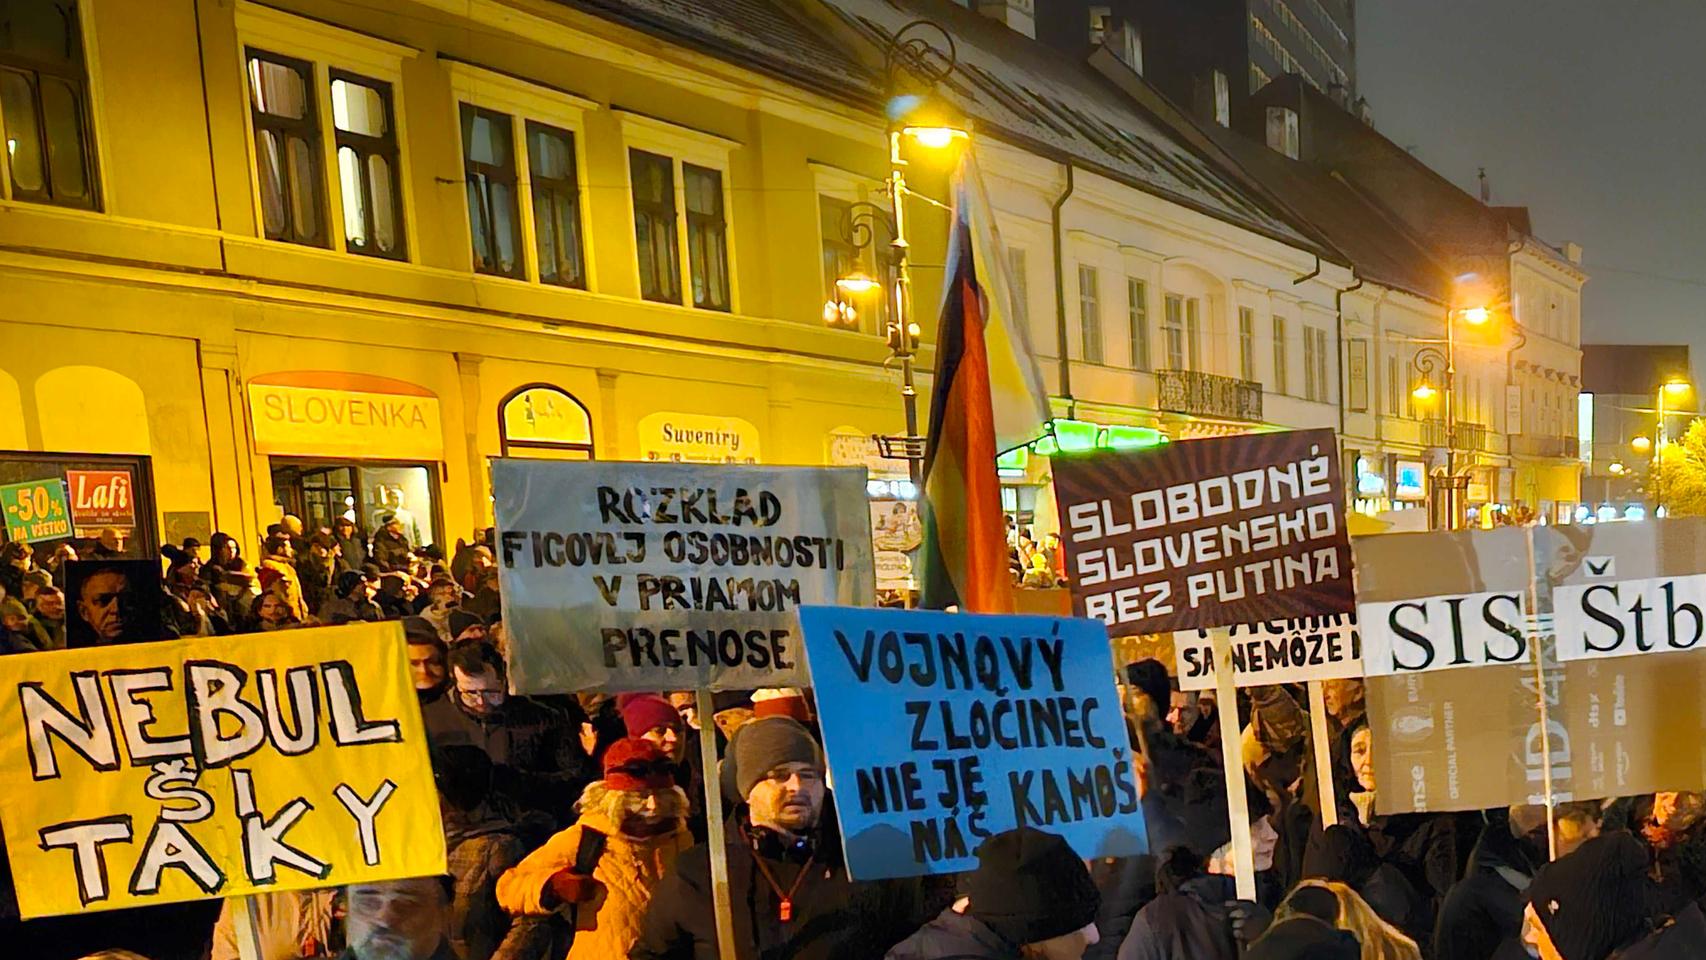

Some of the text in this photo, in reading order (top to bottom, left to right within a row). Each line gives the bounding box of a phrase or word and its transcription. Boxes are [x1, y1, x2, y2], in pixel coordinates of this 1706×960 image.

[264, 393, 428, 430] SLOVENKA
[76, 474, 129, 509] Lafi
[596, 486, 782, 527] ROZKLAD
[1068, 444, 1332, 543] SLOBODNÉ
[13, 526, 28, 542] NA
[31, 519, 67, 538] VŠETKO
[663, 530, 844, 571] OSOBNOSTI
[1076, 502, 1336, 587] SLOVENSKO
[592, 573, 801, 612] V PRIAMOM
[1084, 580, 1174, 628] BEZ
[1186, 547, 1341, 609] PUTINA
[600, 627, 794, 670] PRENOSE
[832, 620, 1065, 692] VOJNOVÝ
[1230, 628, 1343, 674] NEMÔŽE
[1388, 594, 1528, 672] SIS
[17, 659, 402, 781] NEBUL
[904, 686, 1107, 751] ZLOČINEC
[1443, 701, 1460, 800] OFFICIAL PARTNER
[144, 758, 256, 823] ŠI
[855, 746, 1138, 828] NIE JE KAMOŠ
[38, 778, 398, 908] TAKY
[908, 806, 994, 864] NÁŠ
